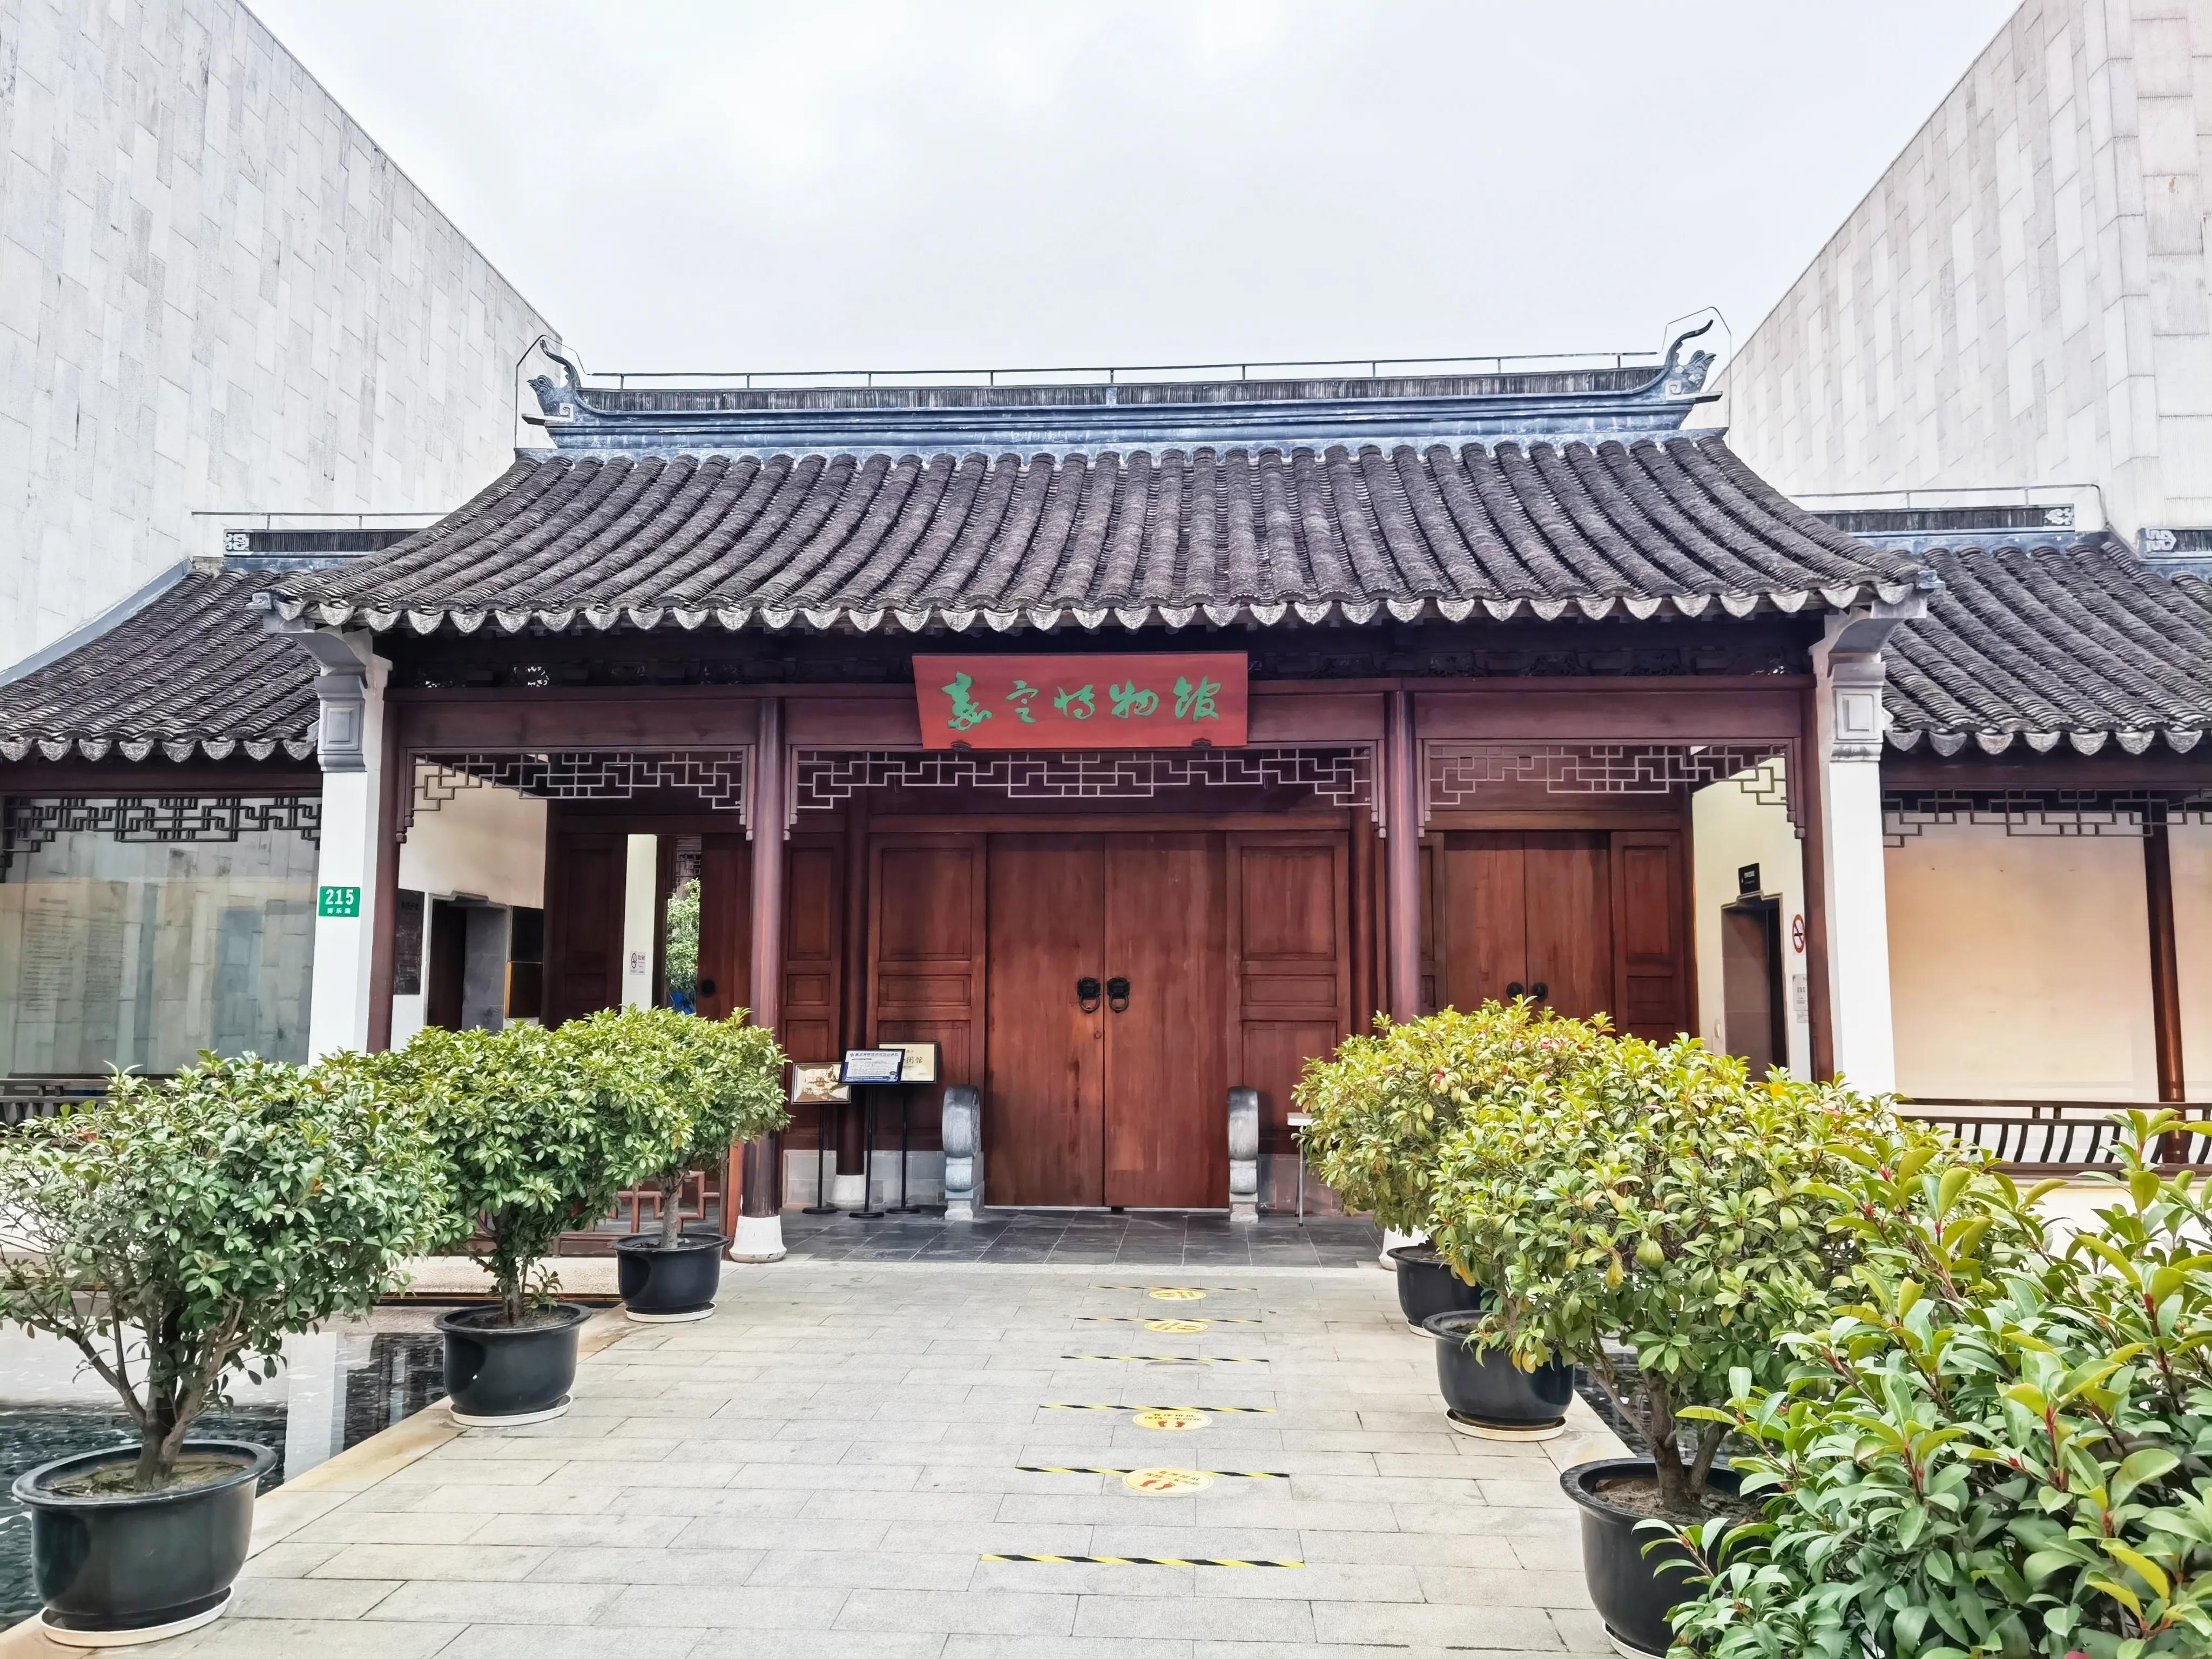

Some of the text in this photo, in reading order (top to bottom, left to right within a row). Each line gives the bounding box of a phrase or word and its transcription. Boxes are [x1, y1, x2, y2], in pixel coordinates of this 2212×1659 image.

[941, 671, 1221, 731] 嘉定博物馆
[325, 889, 354, 905] 215
